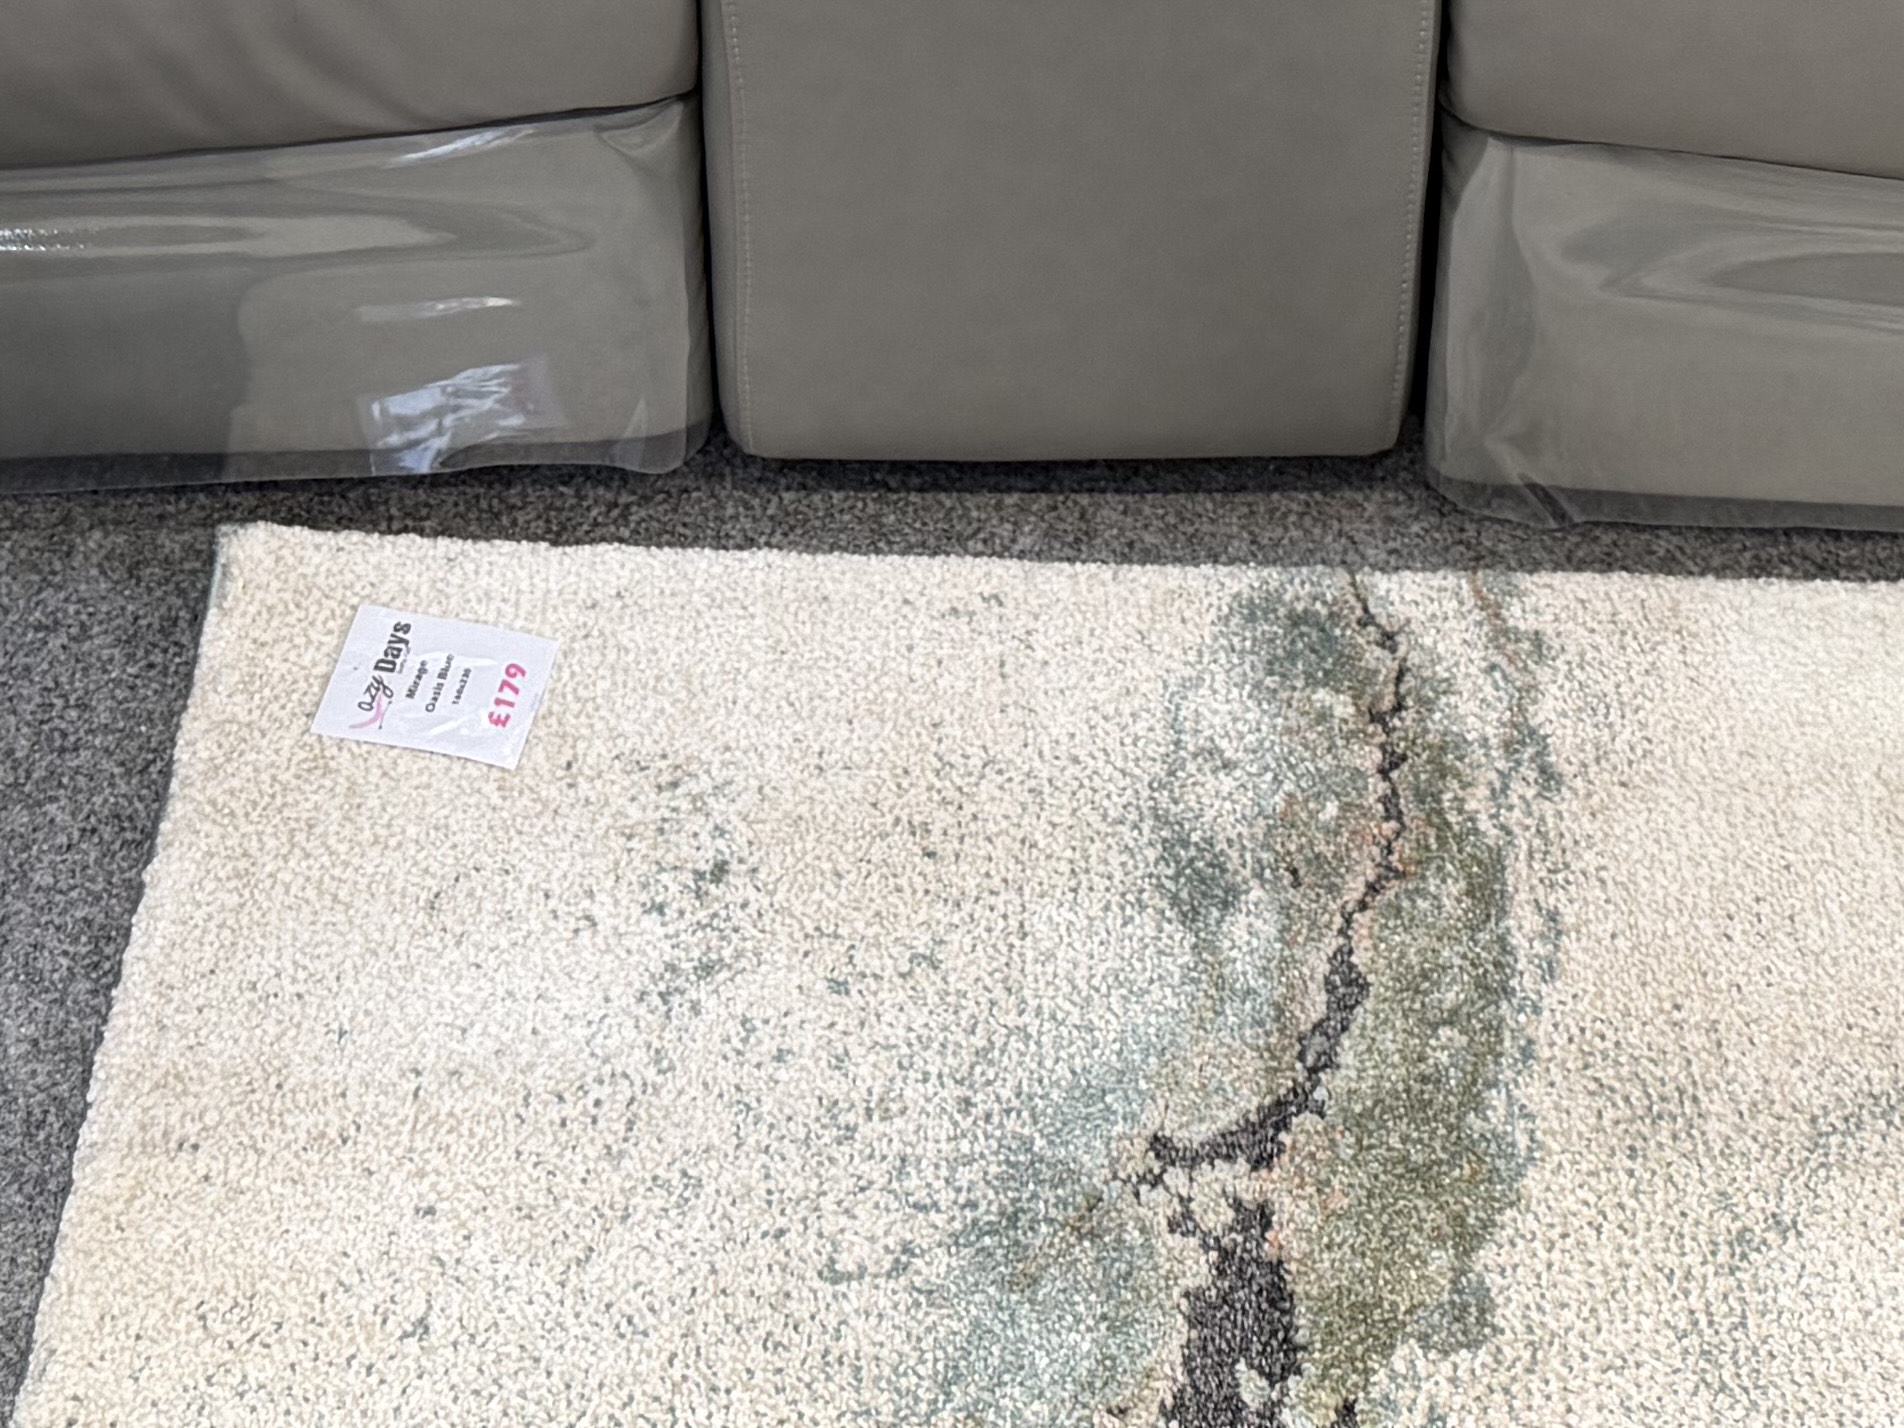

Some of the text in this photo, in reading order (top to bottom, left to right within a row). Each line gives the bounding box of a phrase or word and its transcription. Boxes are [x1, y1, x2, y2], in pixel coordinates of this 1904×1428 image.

[373, 620, 413, 674] Days
[405, 659, 429, 700] Mirage
[424, 652, 456, 713] Oasis Blue
[487, 662, 528, 729] £179
